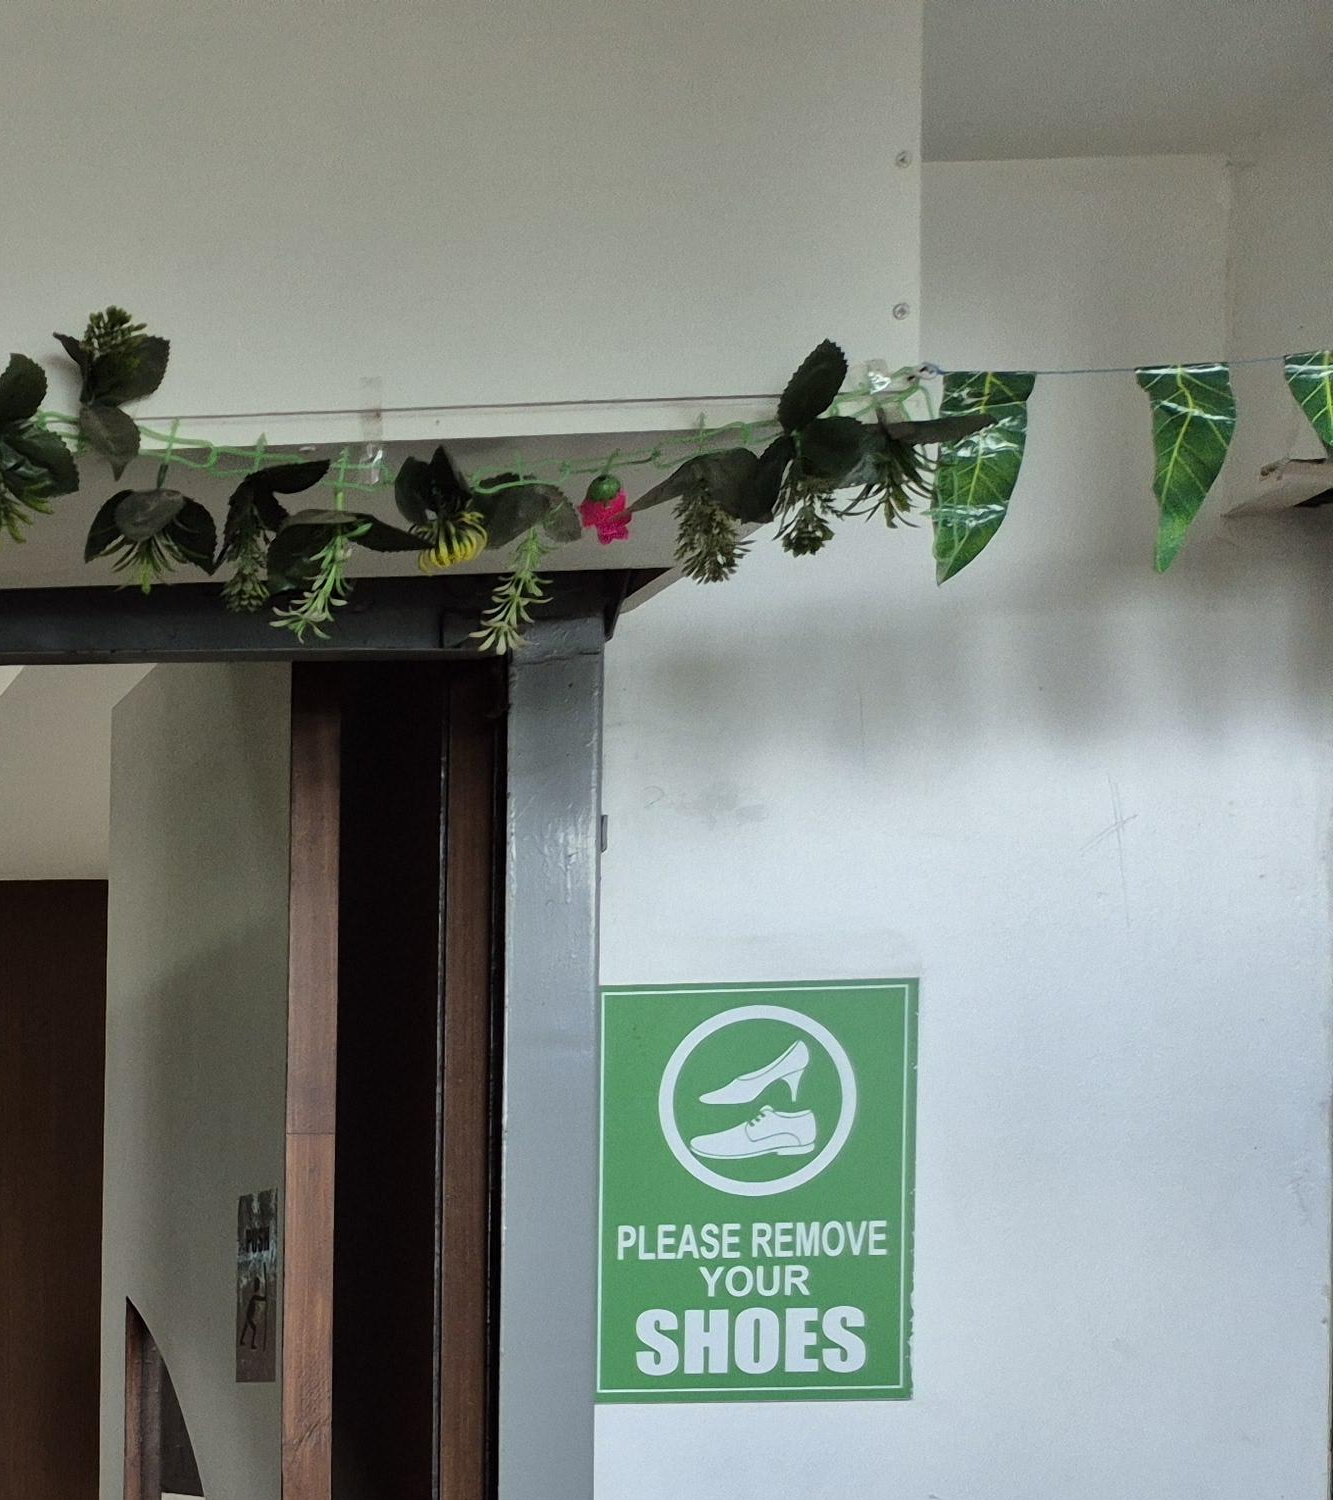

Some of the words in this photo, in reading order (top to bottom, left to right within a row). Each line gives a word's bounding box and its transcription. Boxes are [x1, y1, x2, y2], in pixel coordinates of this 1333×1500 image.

[246, 1226, 270, 1252] PUSH
[618, 1224, 741, 1260] PLEASE
[752, 1221, 887, 1257] REMOVE
[699, 1265, 810, 1297] YOUR
[636, 1306, 866, 1376] SHOES
